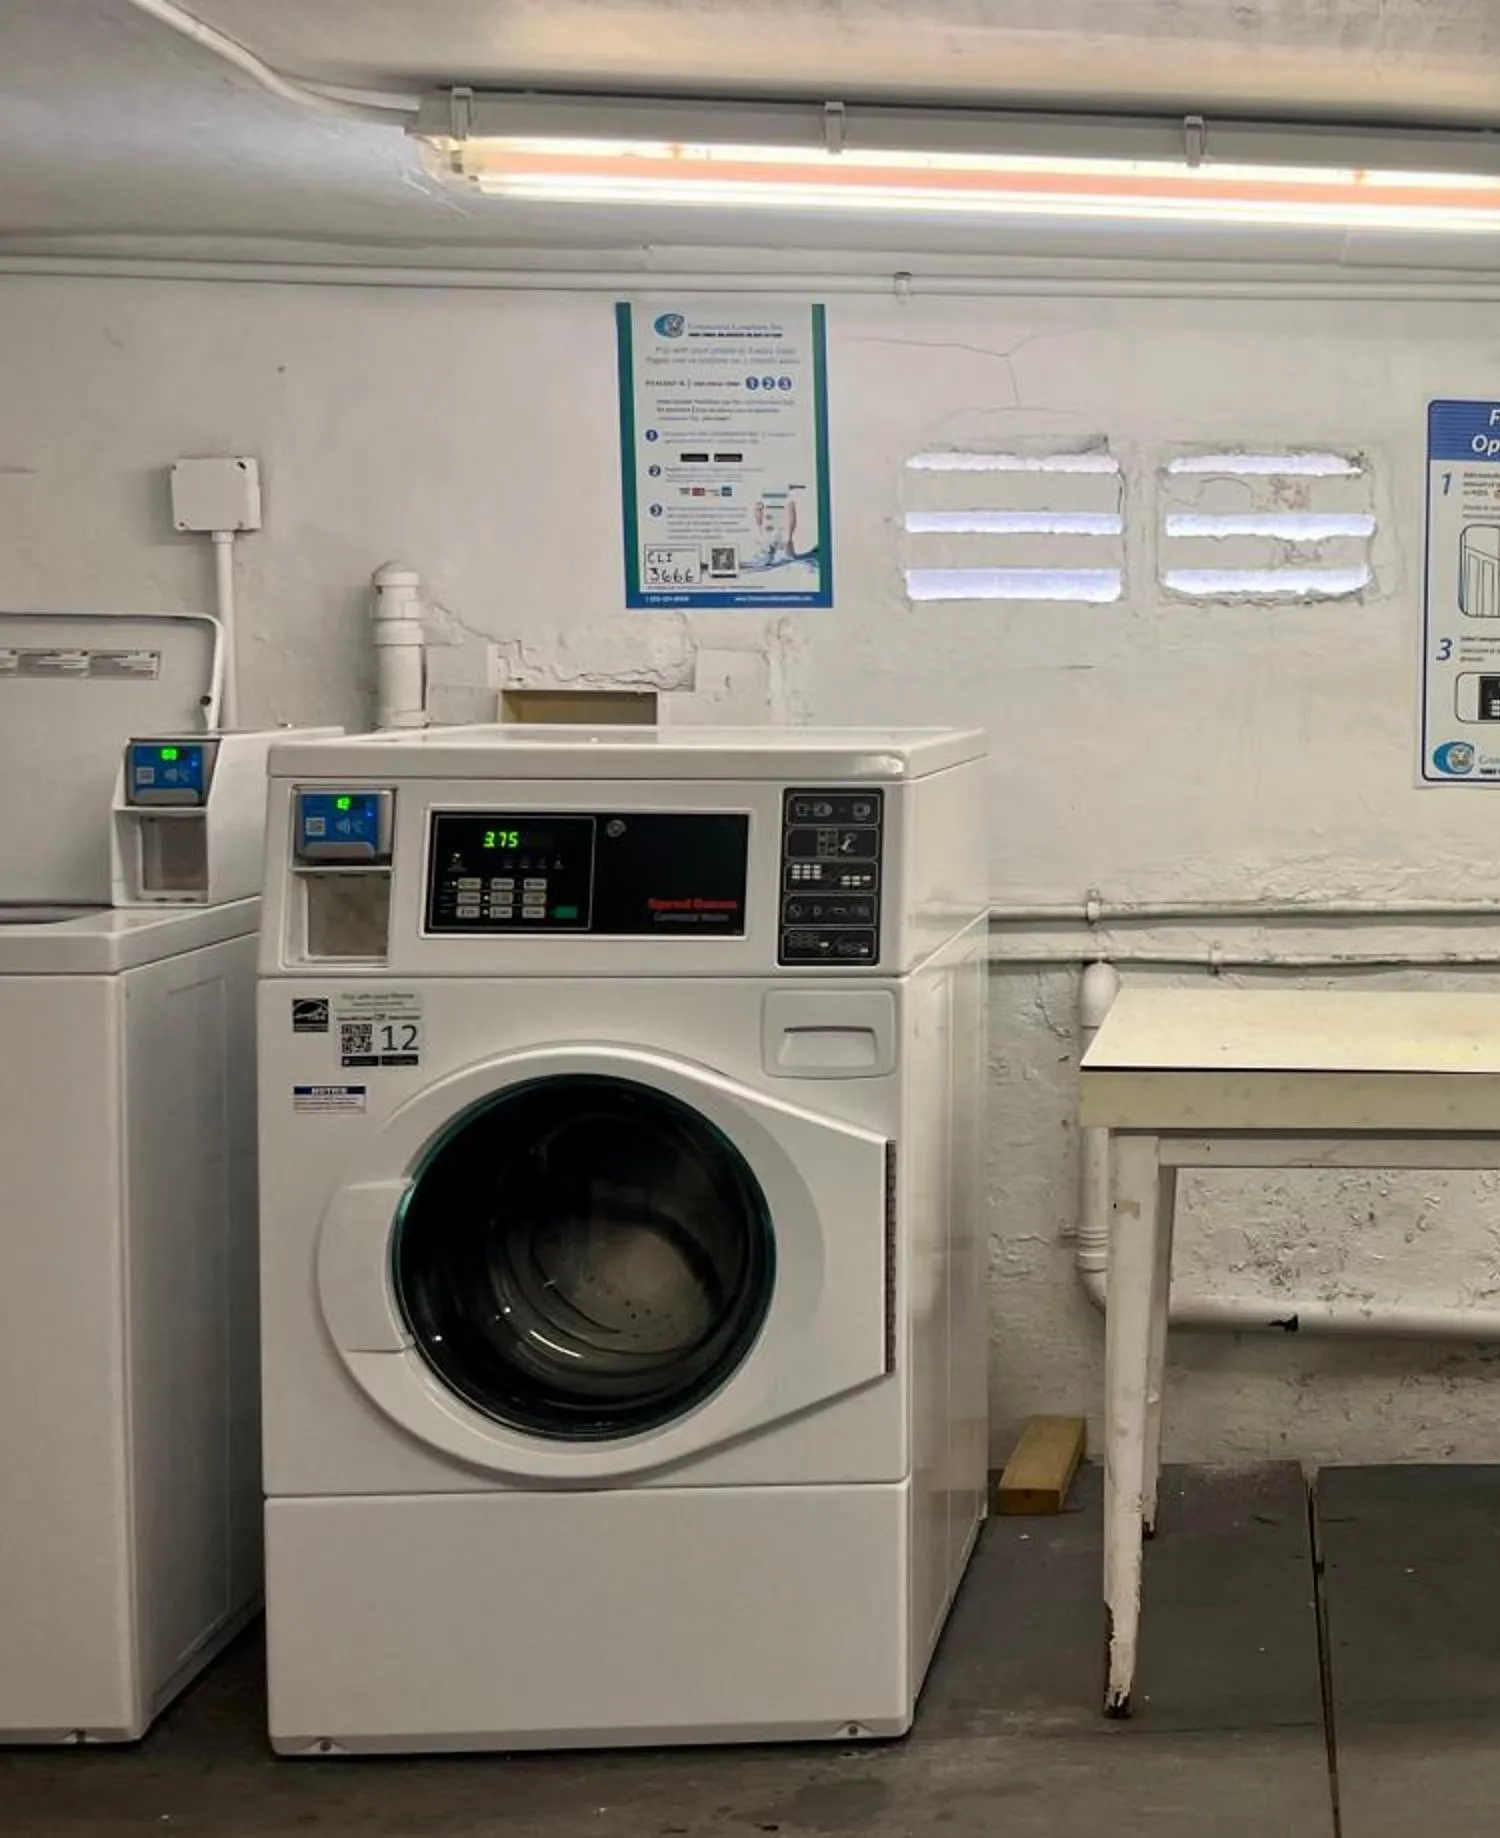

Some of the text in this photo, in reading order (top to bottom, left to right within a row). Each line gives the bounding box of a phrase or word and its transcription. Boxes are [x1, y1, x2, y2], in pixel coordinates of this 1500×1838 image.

[1441, 472, 1453, 497] 1
[1436, 637, 1453, 661] 3
[381, 1024, 419, 1051] 12
